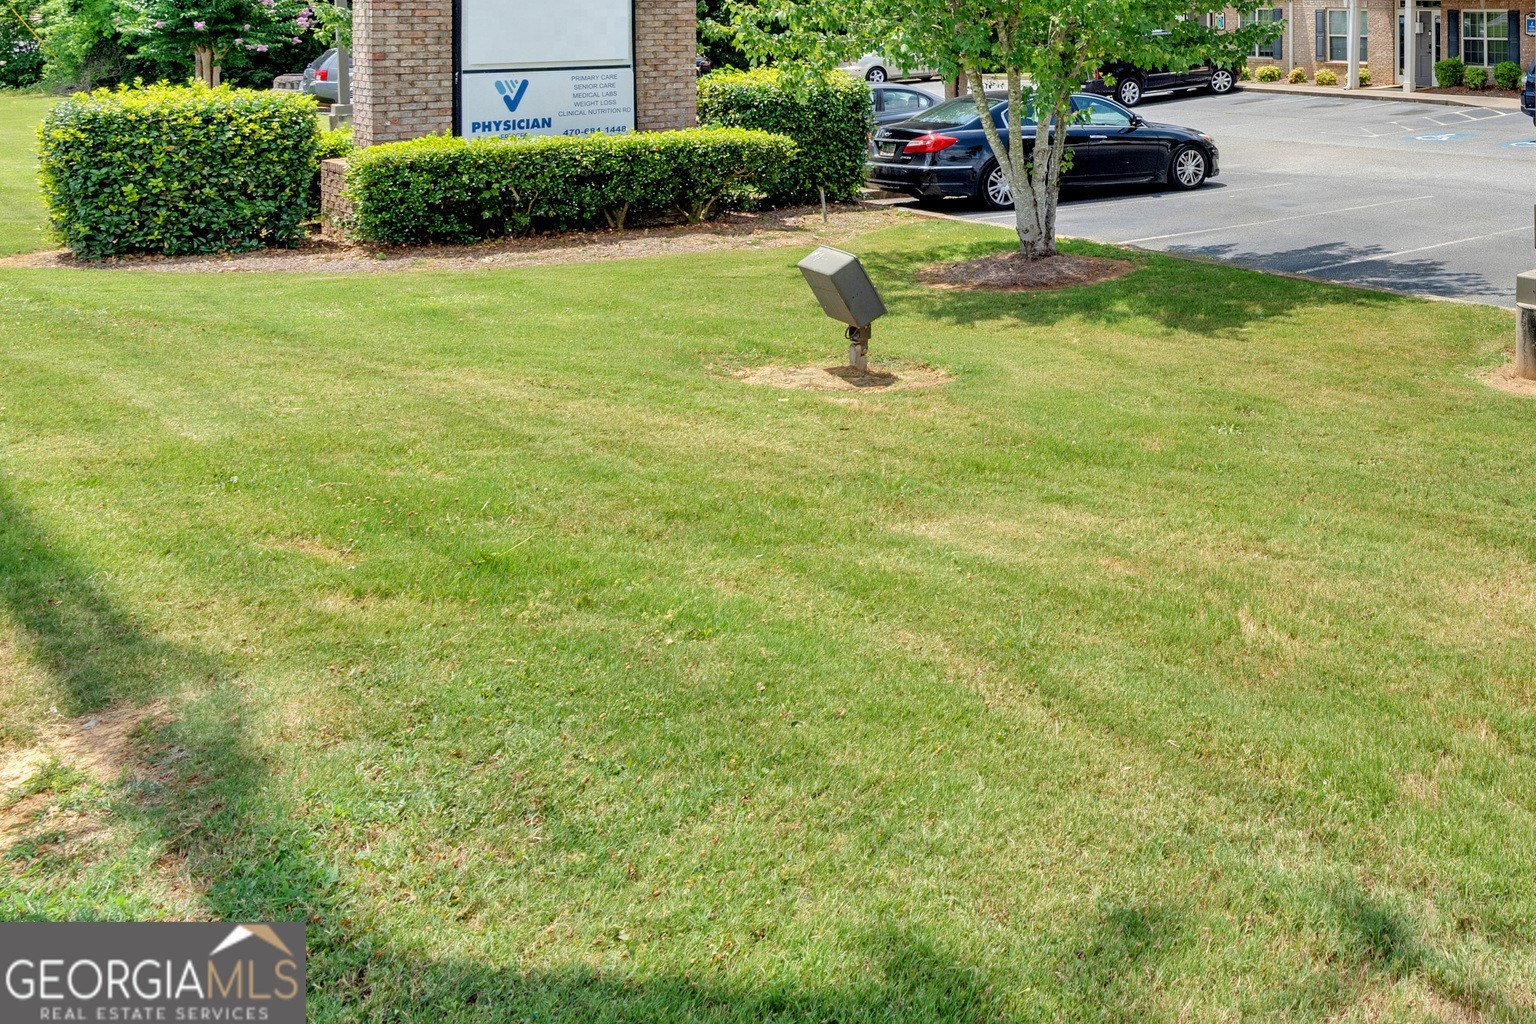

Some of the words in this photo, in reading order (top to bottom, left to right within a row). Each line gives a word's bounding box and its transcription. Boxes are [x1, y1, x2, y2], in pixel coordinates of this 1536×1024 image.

[557, 109, 587, 117] CLINICAL
[587, 107, 621, 115] NUTRITION
[471, 117, 552, 133] PHYSICIAN
